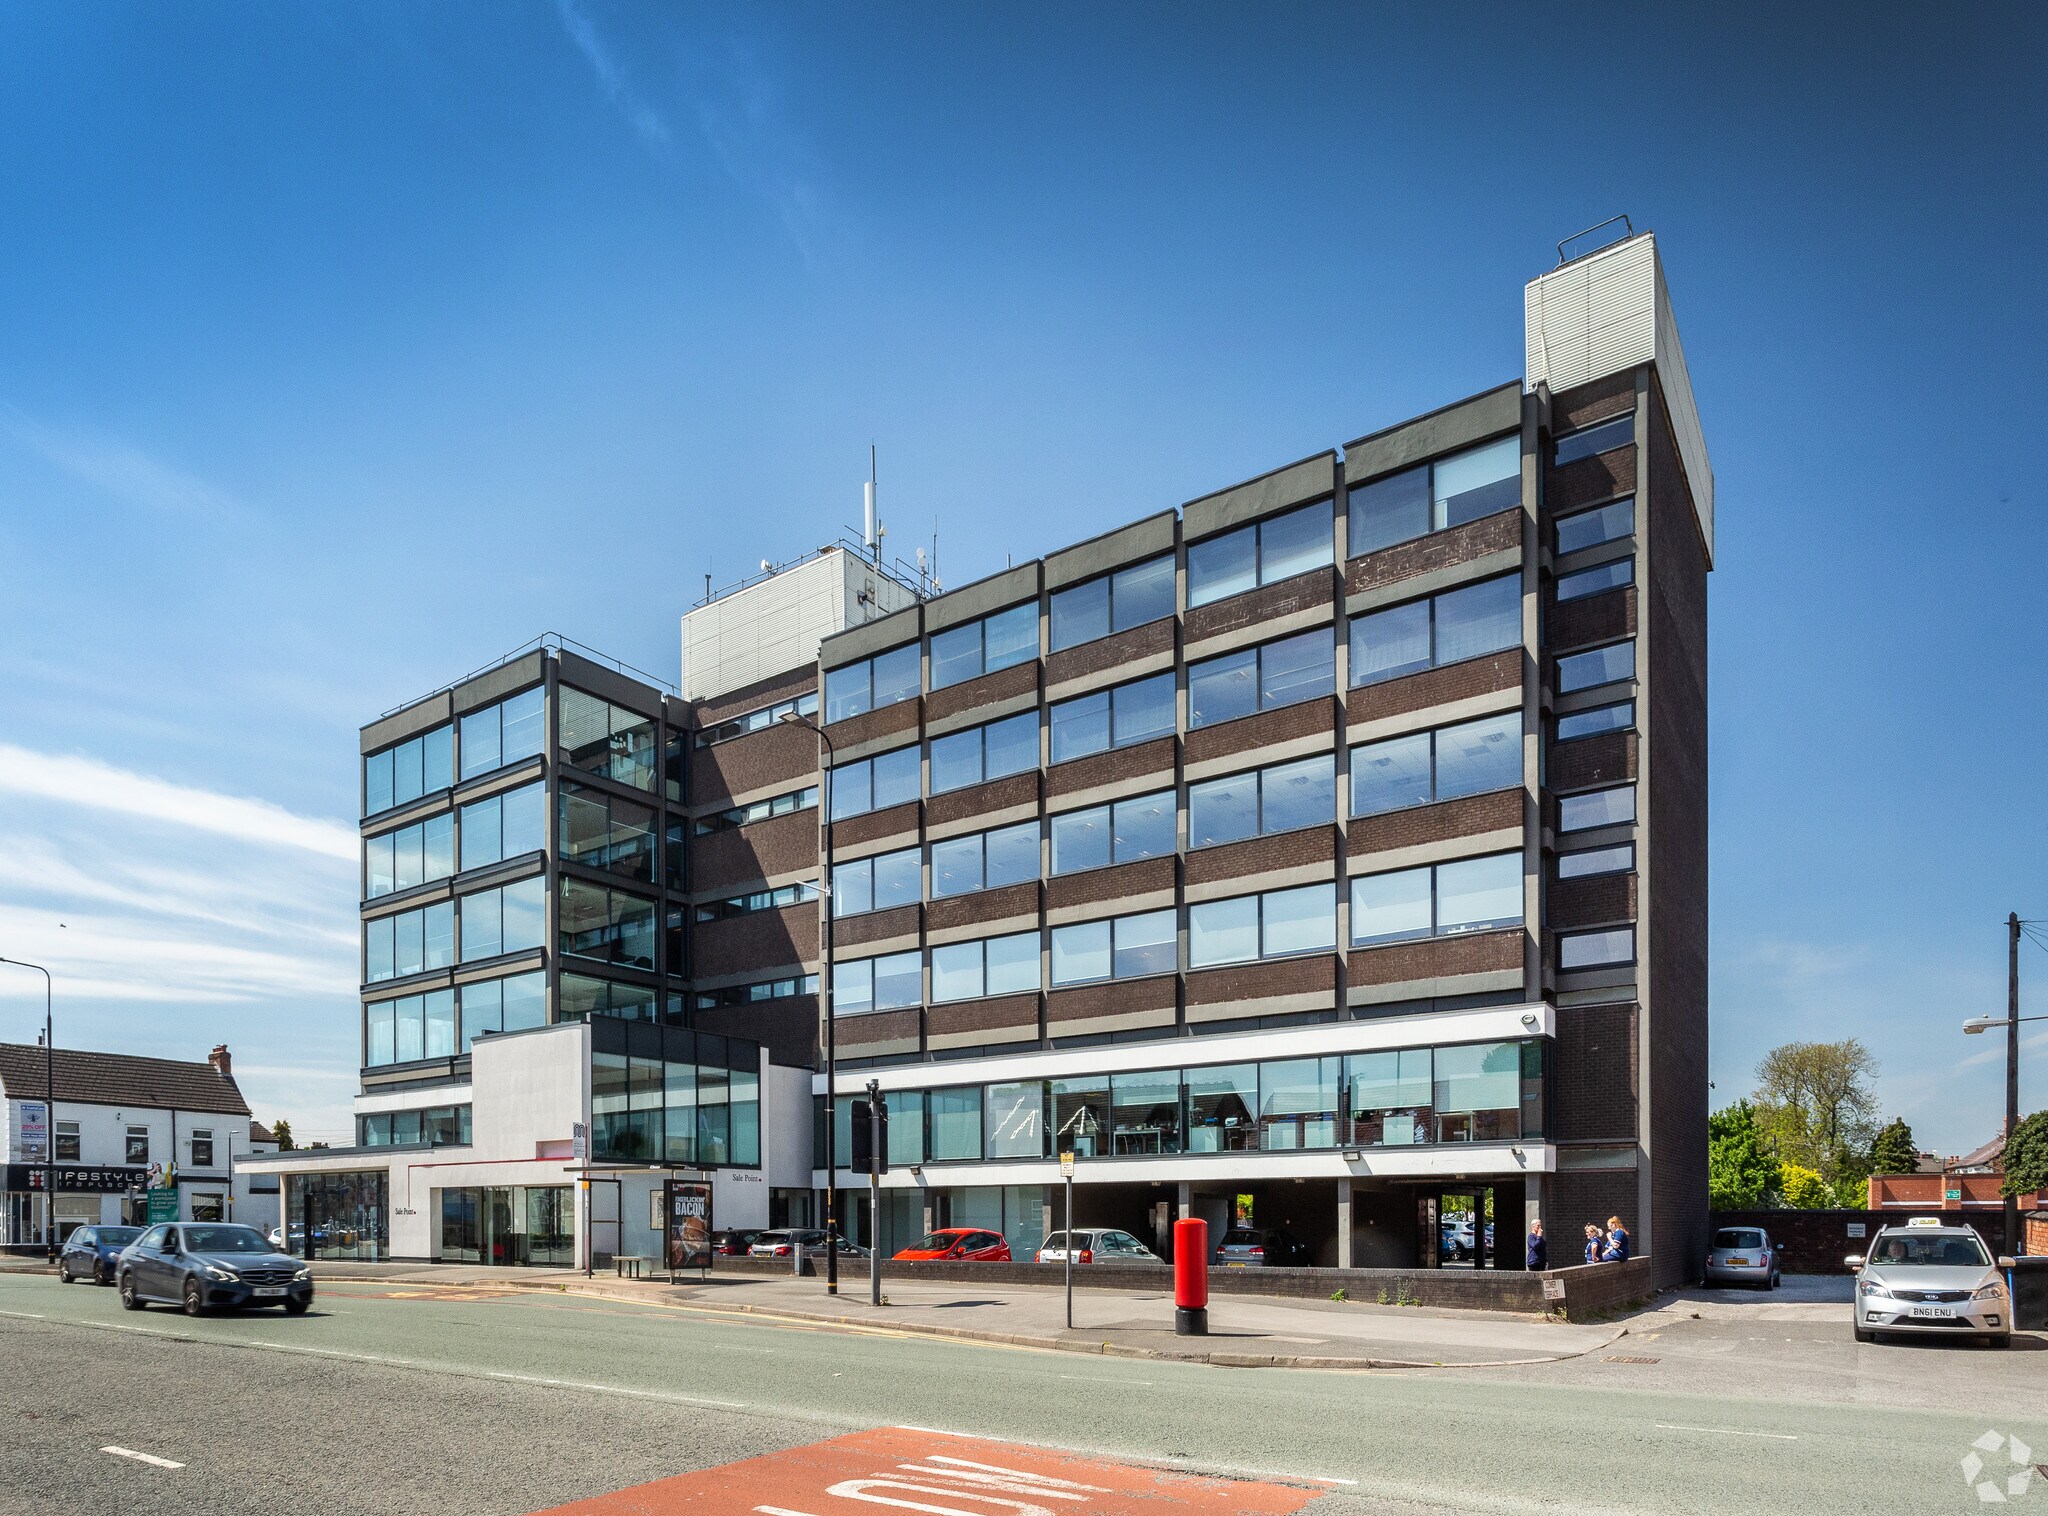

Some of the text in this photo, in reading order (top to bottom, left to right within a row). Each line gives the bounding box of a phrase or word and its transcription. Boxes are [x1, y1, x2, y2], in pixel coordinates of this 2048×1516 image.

[732, 1173, 744, 1182] Sale
[675, 1202, 705, 1216] BACON
[1913, 1307, 1951, 1317] BN61 ENU
